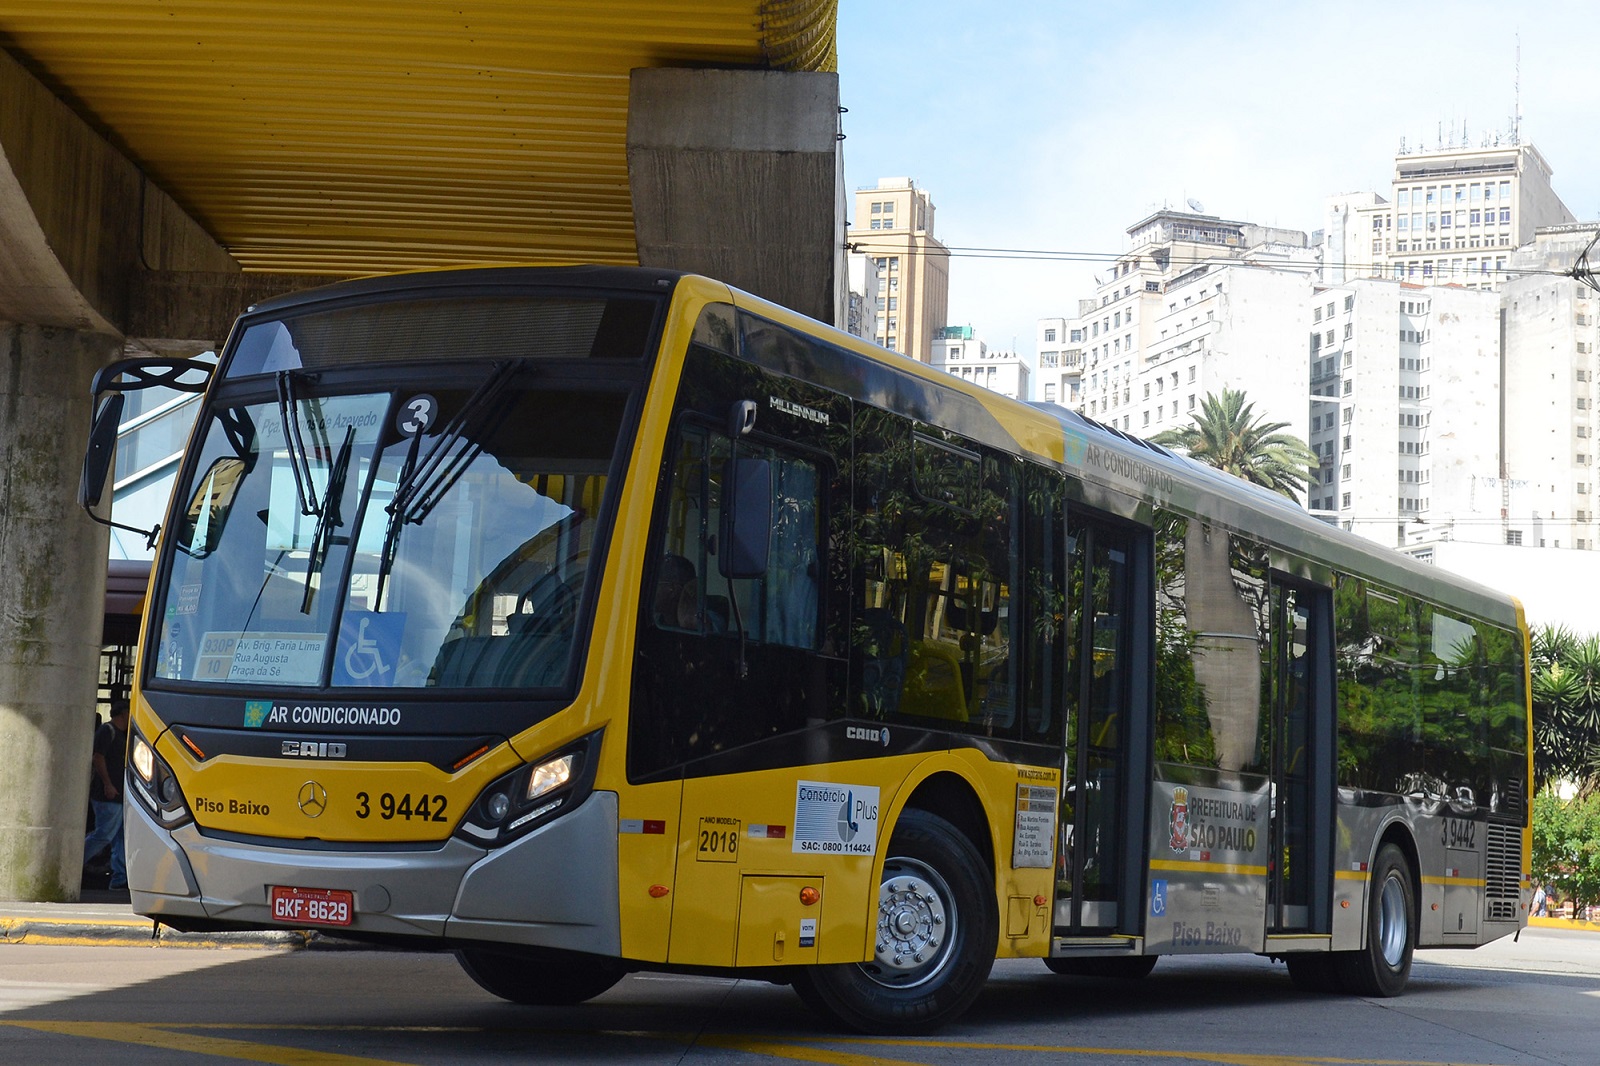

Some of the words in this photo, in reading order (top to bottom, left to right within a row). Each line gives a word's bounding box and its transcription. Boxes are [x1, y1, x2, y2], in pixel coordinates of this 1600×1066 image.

[402, 399, 431, 433] 3
[769, 395, 829, 426] MILLENNIUM
[333, 411, 378, 430] Azevedo
[1087, 443, 1101, 467] AR
[1104, 450, 1173, 494] CONDICIONADO
[204, 638, 235, 653] 930P
[237, 641, 250, 650] Av.
[253, 641, 272, 652] Brig.
[274, 641, 296, 651] Faria
[298, 641, 320, 651] Lima
[207, 659, 220, 674] 10
[235, 653, 251, 662] Rua
[252, 654, 289, 665] Augusta
[231, 665, 255, 676] Praça
[258, 665, 267, 675] da
[269, 666, 281, 676] Sé
[269, 706, 288, 723] AR
[292, 706, 401, 726] CONDICIONADO
[846, 726, 880, 742] CAIO
[281, 740, 347, 758] CAIO
[799, 787, 846, 803] Consórcio
[195, 797, 224, 813] Piso
[229, 799, 270, 816] Baixo
[355, 791, 370, 819] 3
[380, 792, 448, 823] 9442
[855, 800, 878, 820] Plus
[1191, 797, 1244, 820] PREFEITURA
[1245, 803, 1256, 822] DE
[704, 816, 715, 824] ANO
[716, 817, 737, 825] MODELO
[699, 830, 737, 853] 2018
[1190, 818, 1216, 849] SÃO
[1218, 826, 1255, 853] PAULO
[1441, 817, 1448, 846] 3
[1450, 818, 1476, 849] 9442
[801, 841, 820, 851] SAC:
[822, 842, 842, 852] 0800
[844, 843, 871, 853] 114424
[1172, 921, 1201, 946] Piso
[1205, 922, 1242, 946] Baixo
